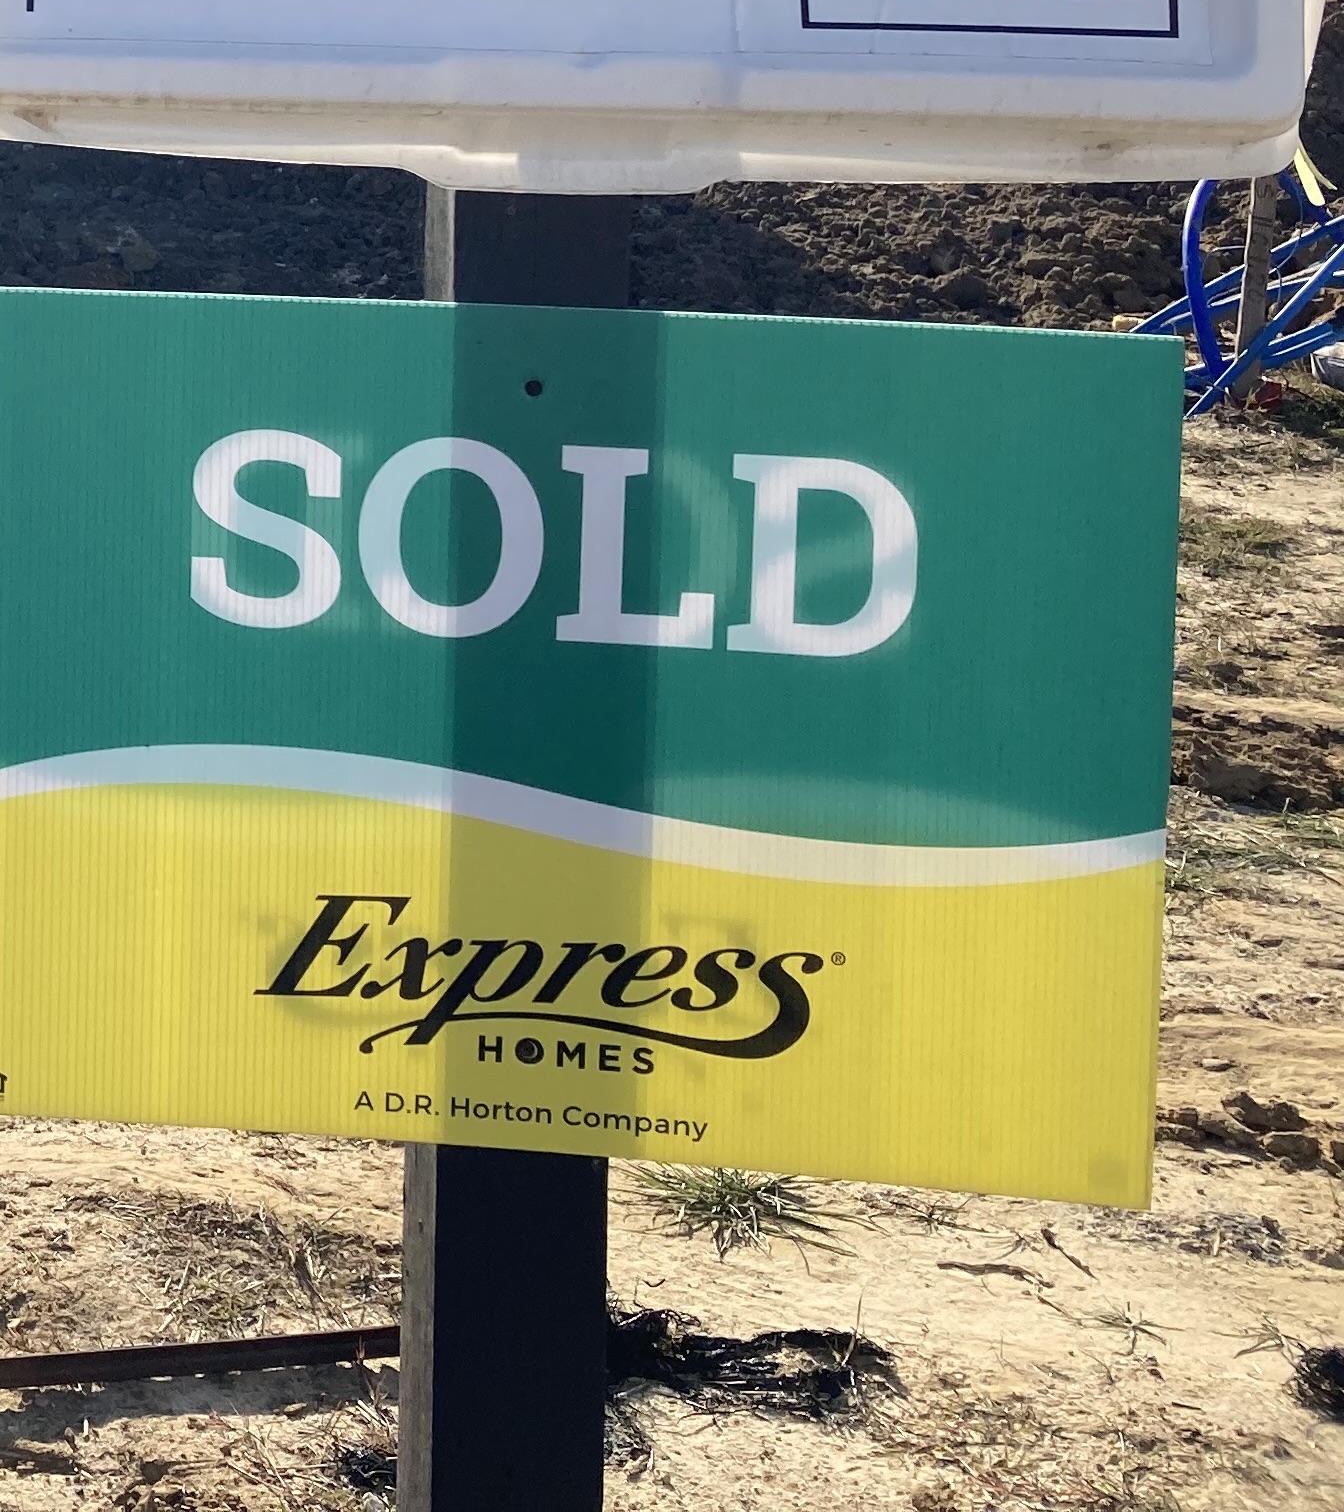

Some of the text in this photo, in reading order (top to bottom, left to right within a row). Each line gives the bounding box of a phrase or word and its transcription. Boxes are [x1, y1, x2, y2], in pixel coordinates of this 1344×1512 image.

[190, 428, 919, 658] SOLD
[477, 1034, 656, 1075] HOMES
[354, 1090, 709, 1143] A D.R. Horton Company
